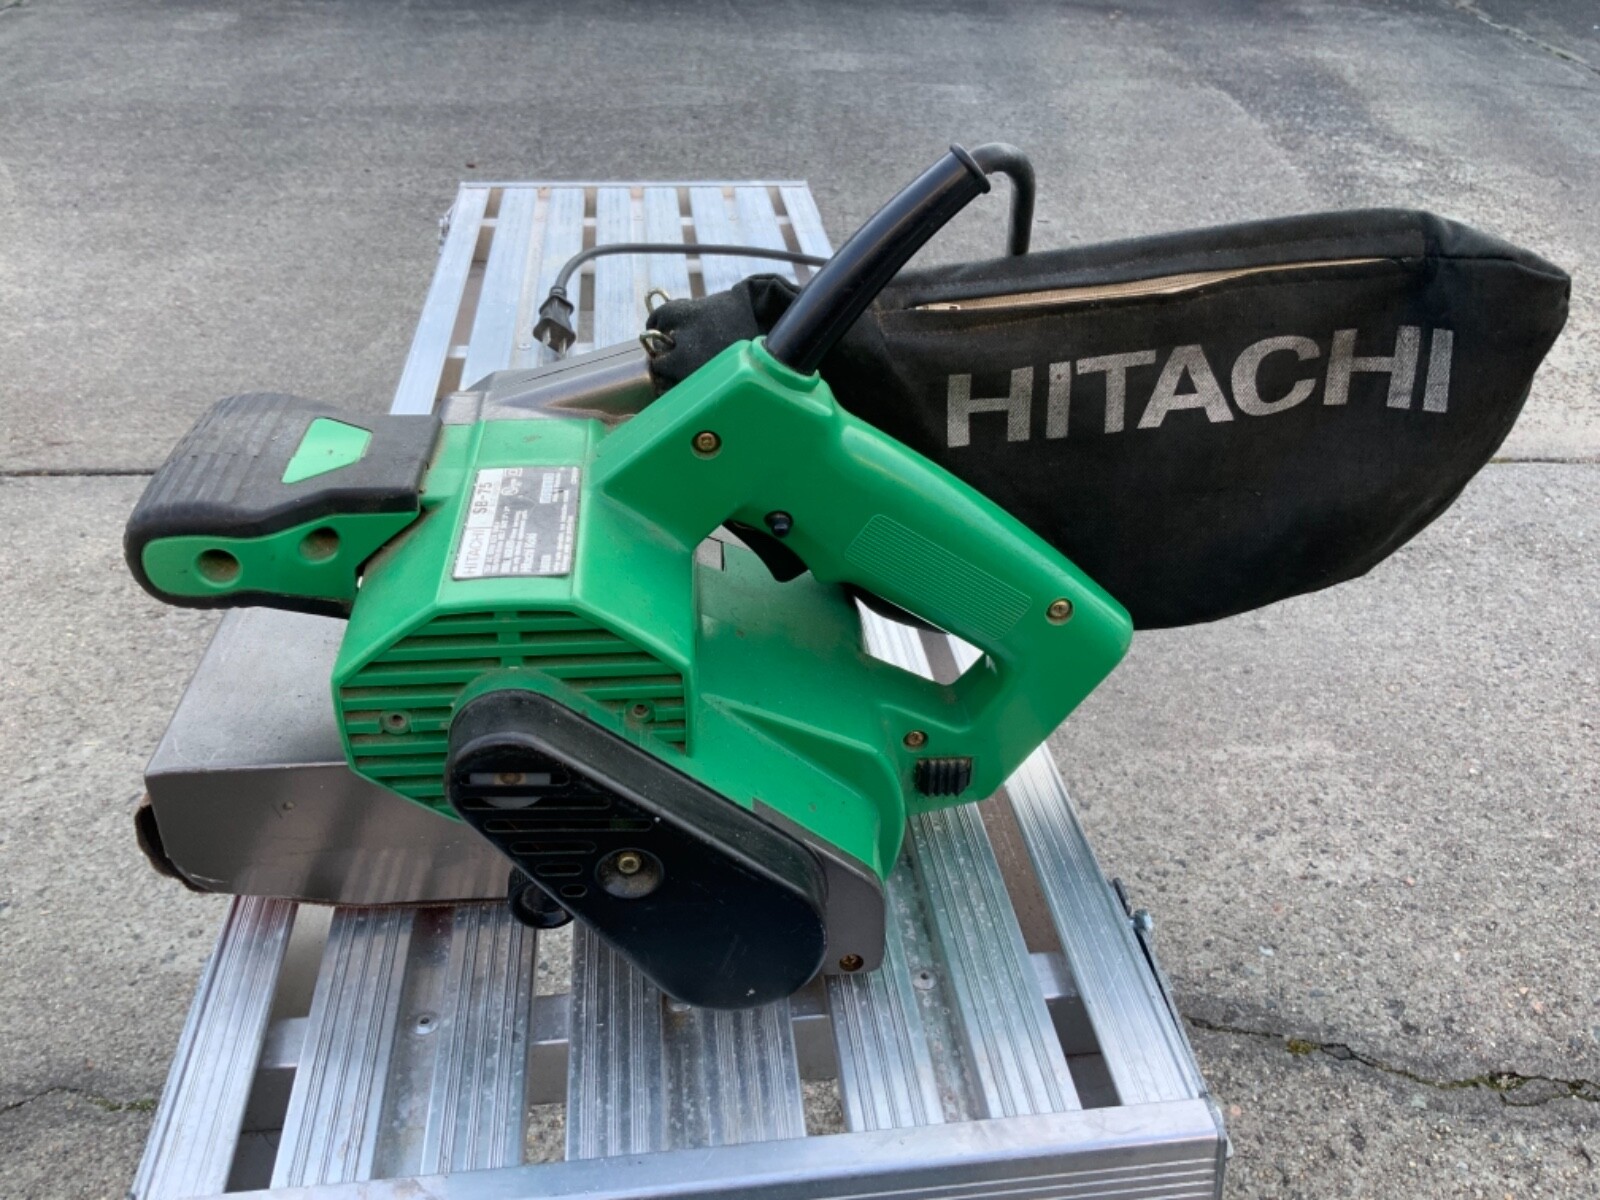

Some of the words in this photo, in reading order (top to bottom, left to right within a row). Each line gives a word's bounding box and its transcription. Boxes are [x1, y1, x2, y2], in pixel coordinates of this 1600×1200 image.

[947, 325, 1454, 448] HITACHI
[472, 482, 492, 515] SB-75
[463, 529, 485, 574] HITACHI
